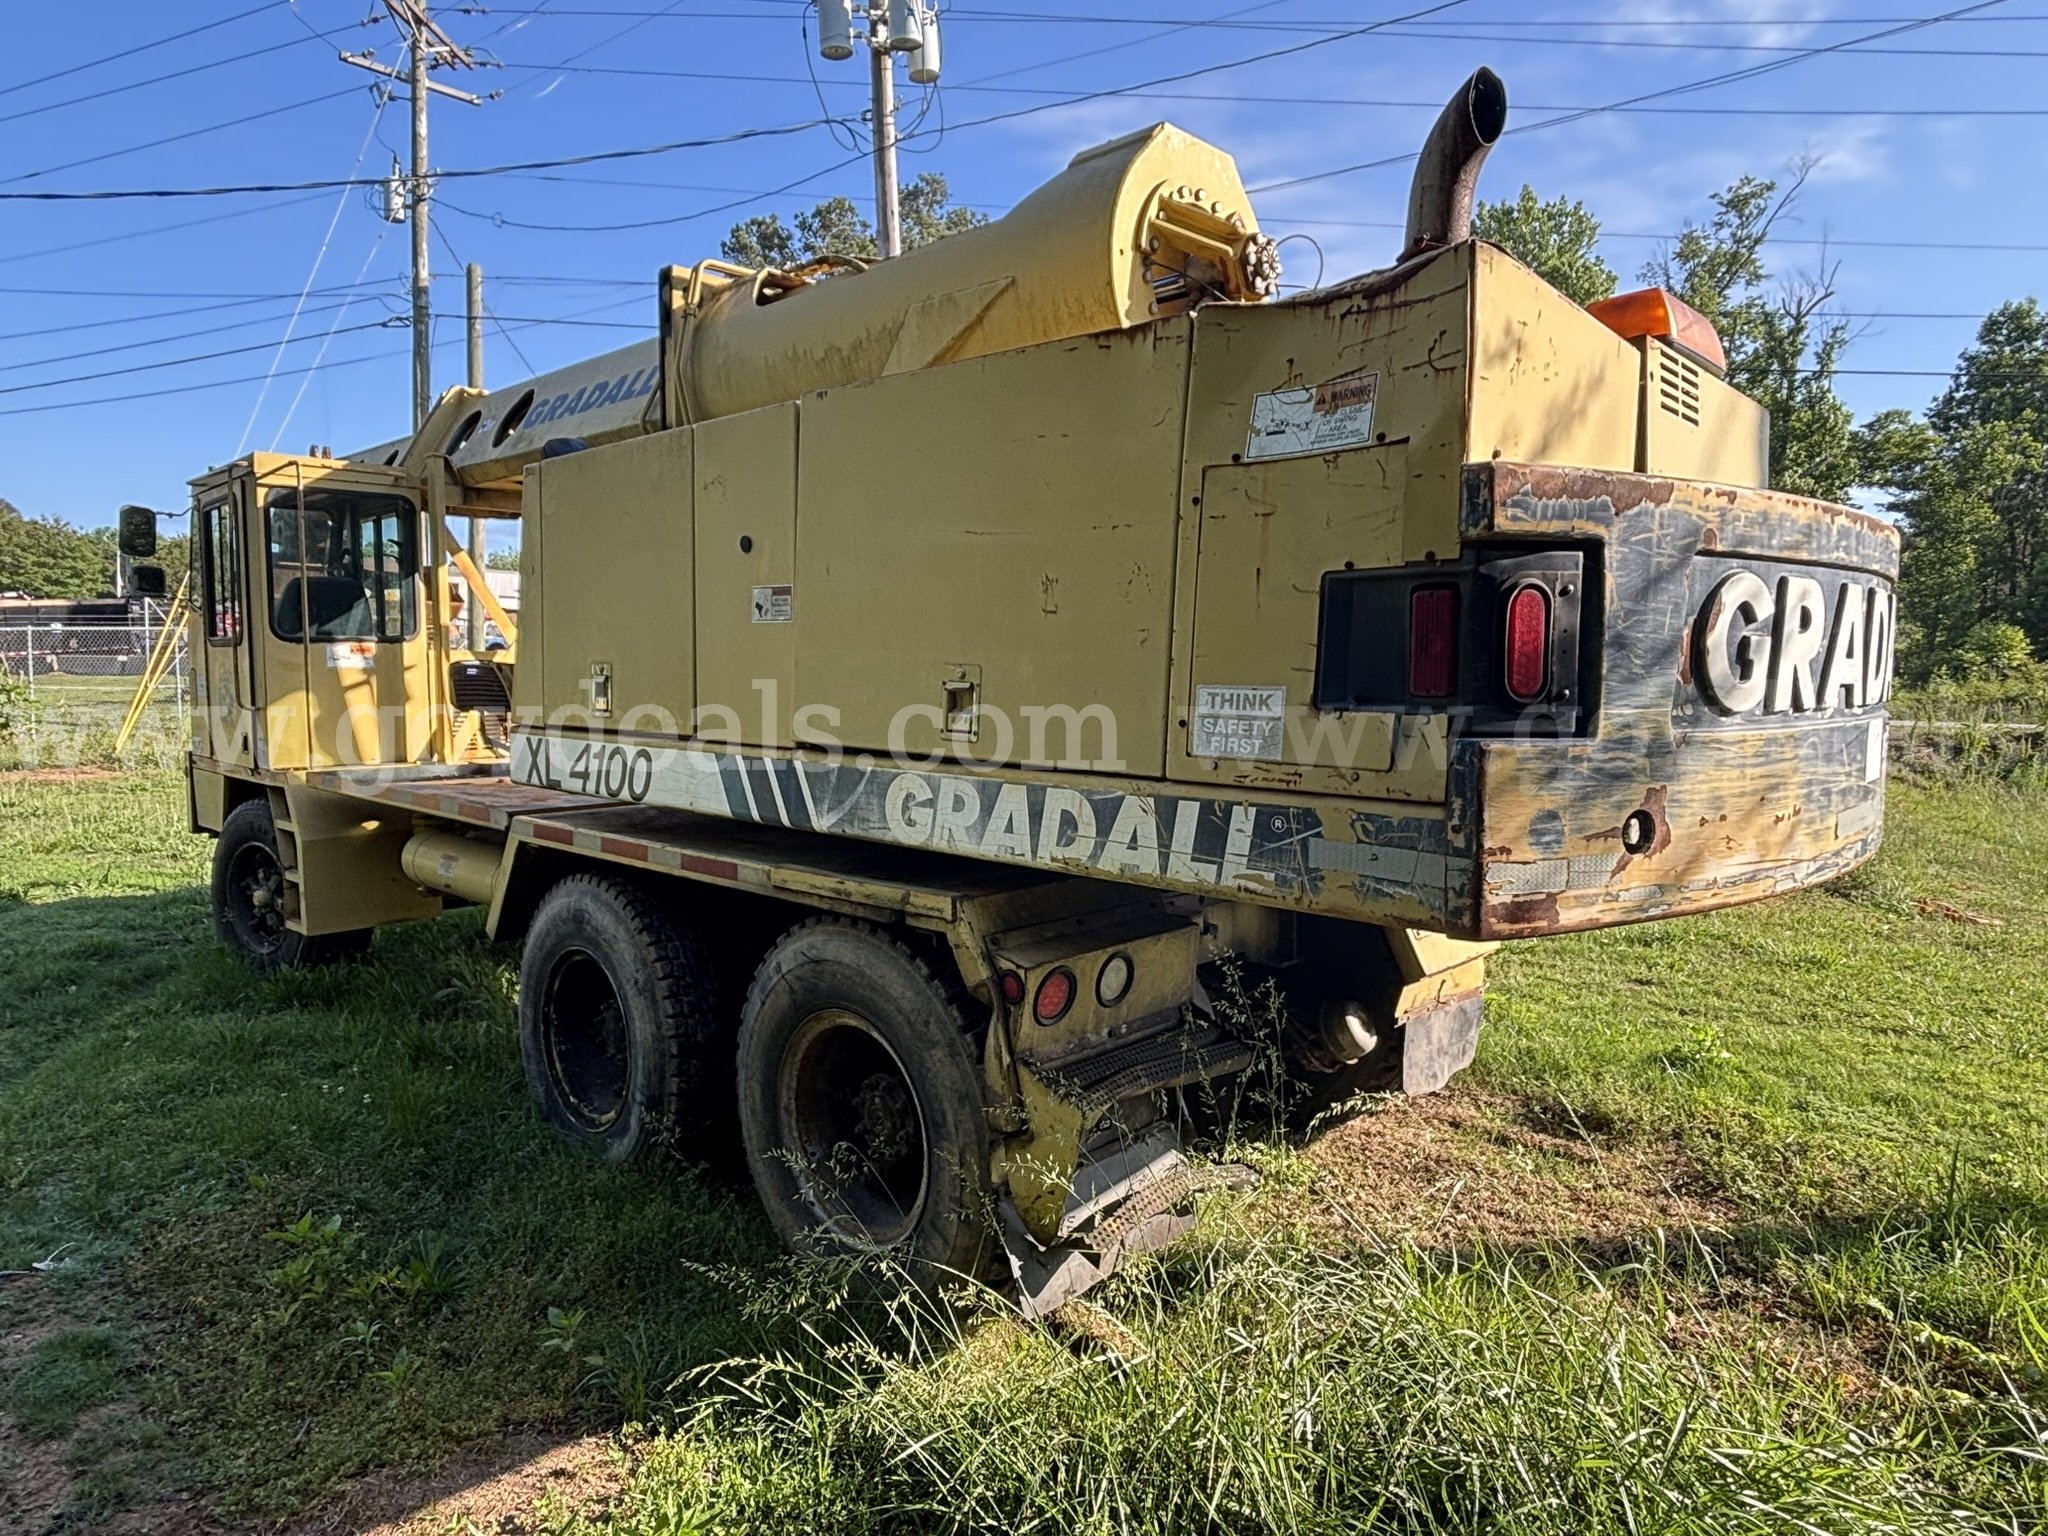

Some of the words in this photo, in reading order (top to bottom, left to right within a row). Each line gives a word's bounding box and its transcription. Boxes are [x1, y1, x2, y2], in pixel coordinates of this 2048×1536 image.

[523, 365, 659, 429] GRADALL
[1331, 383, 1372, 402] WARNING
[1206, 692, 1274, 712] THINK
[1202, 718, 1273, 736] SAFETY
[1209, 736, 1264, 754] FIRST
[526, 736, 562, 789] XL
[569, 743, 653, 802] 4100
[885, 771, 1276, 891] GRADALL
